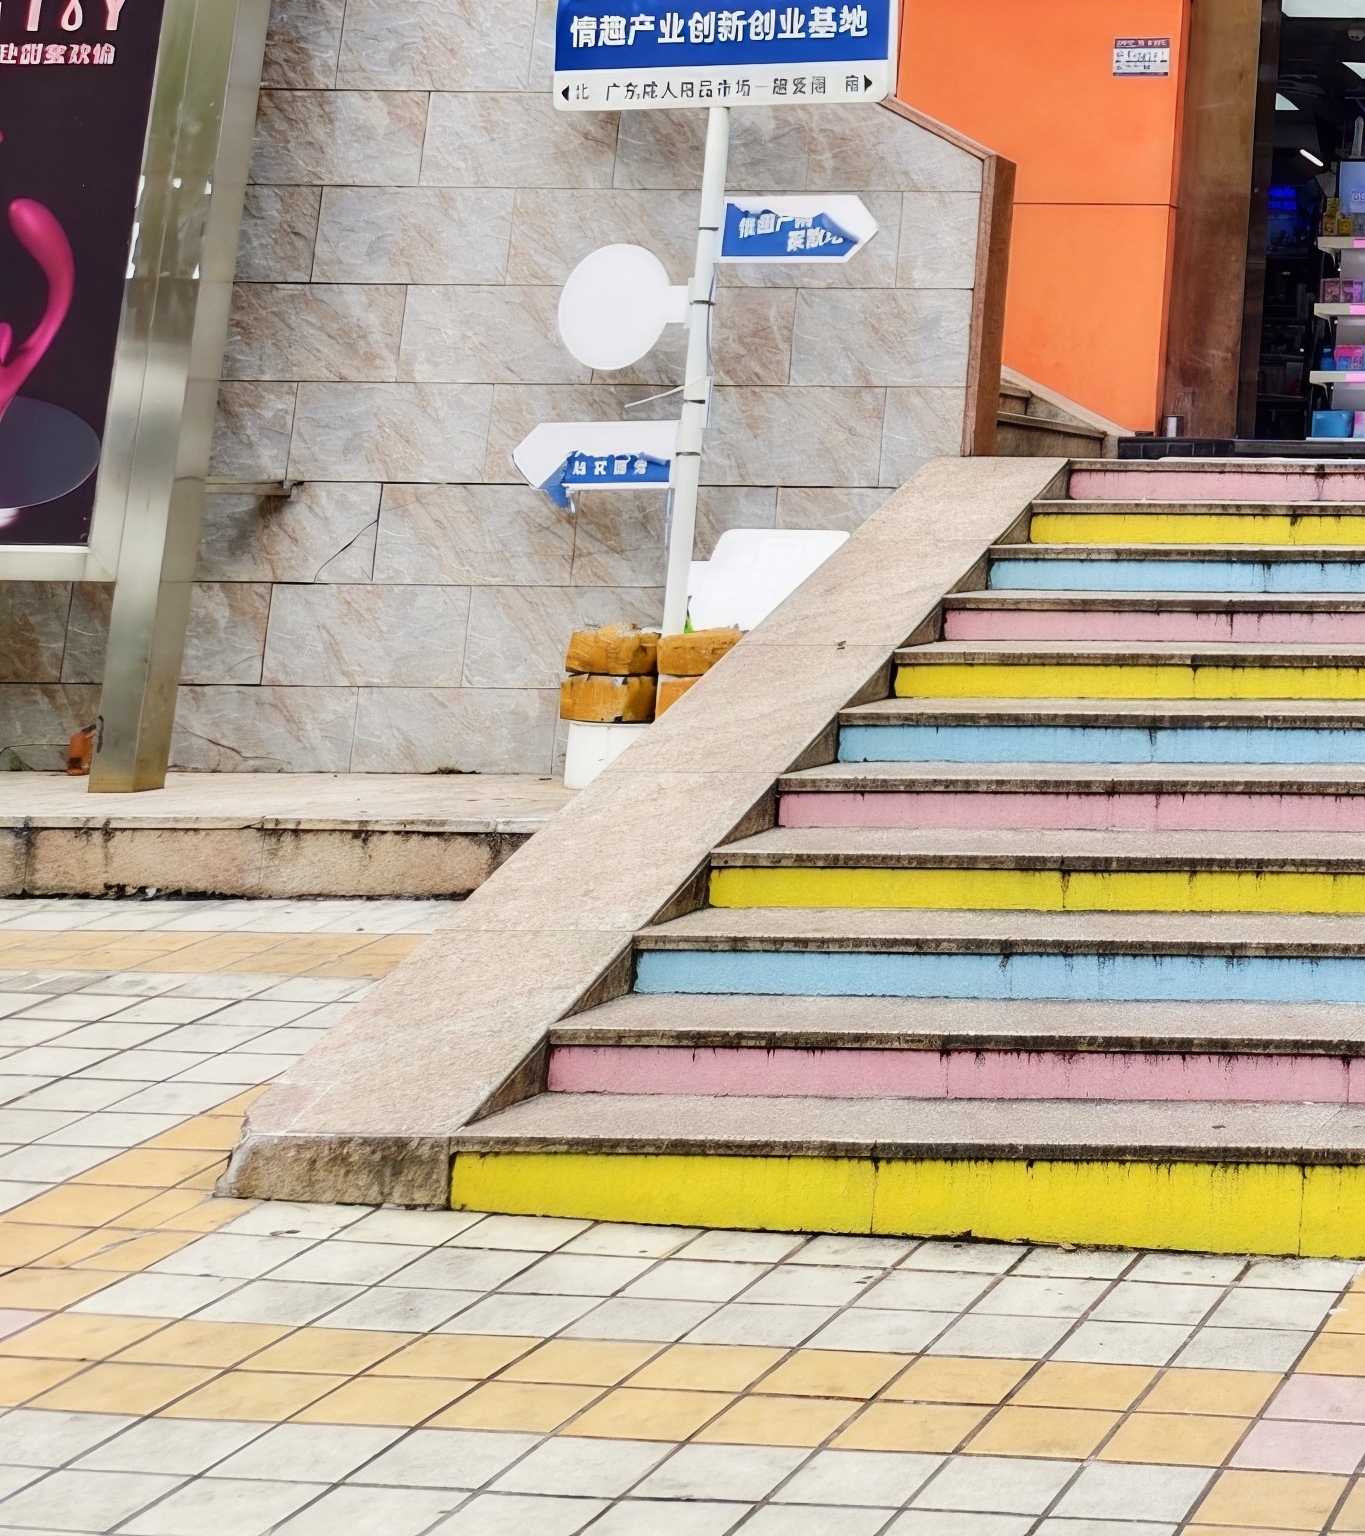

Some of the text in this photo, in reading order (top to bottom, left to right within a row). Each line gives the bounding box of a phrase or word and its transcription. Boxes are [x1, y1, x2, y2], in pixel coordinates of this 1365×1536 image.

[570, 4, 868, 48] 情趣产业创新创业基地
